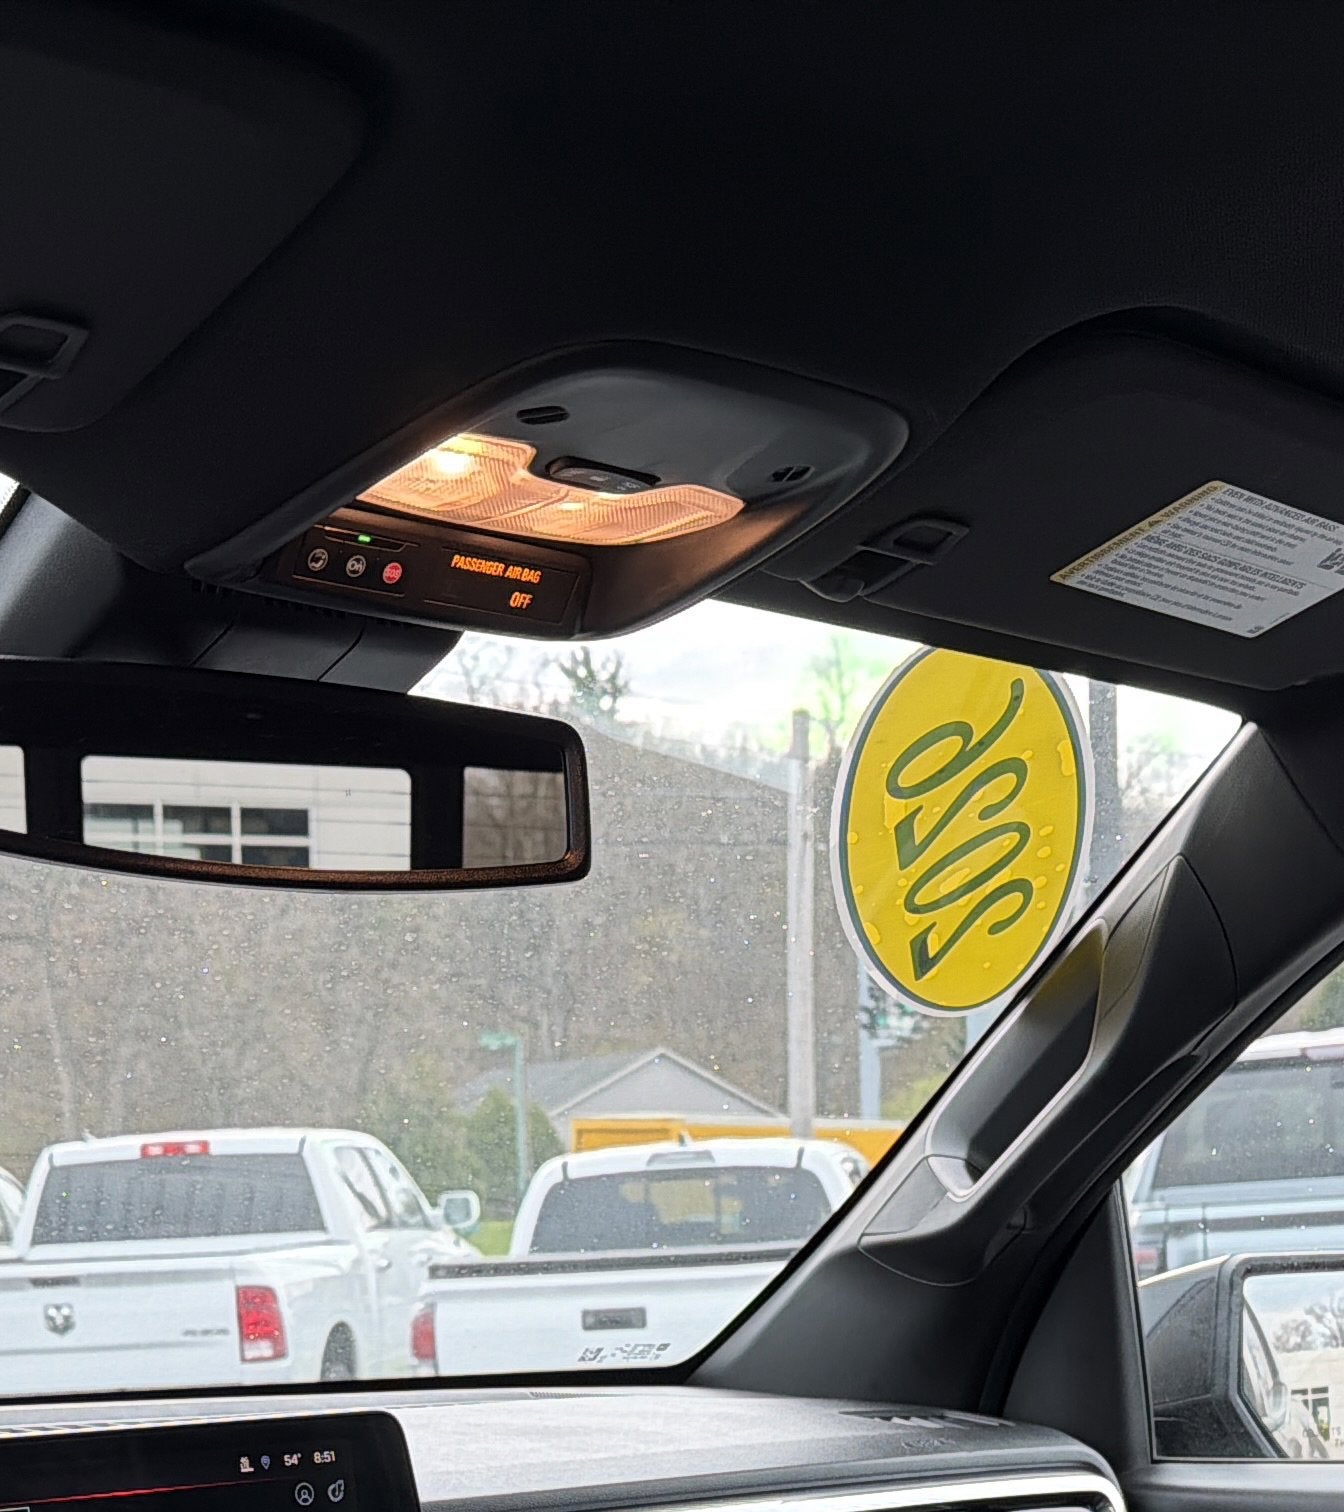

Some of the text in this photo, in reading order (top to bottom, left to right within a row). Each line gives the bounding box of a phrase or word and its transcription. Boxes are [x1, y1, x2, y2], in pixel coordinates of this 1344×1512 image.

[384, 567, 402, 579] SOS
[451, 554, 542, 583] PASSENGER AIR BAG
[510, 592, 533, 608] OFF
[282, 1451, 336, 1466] 54° 8:51
